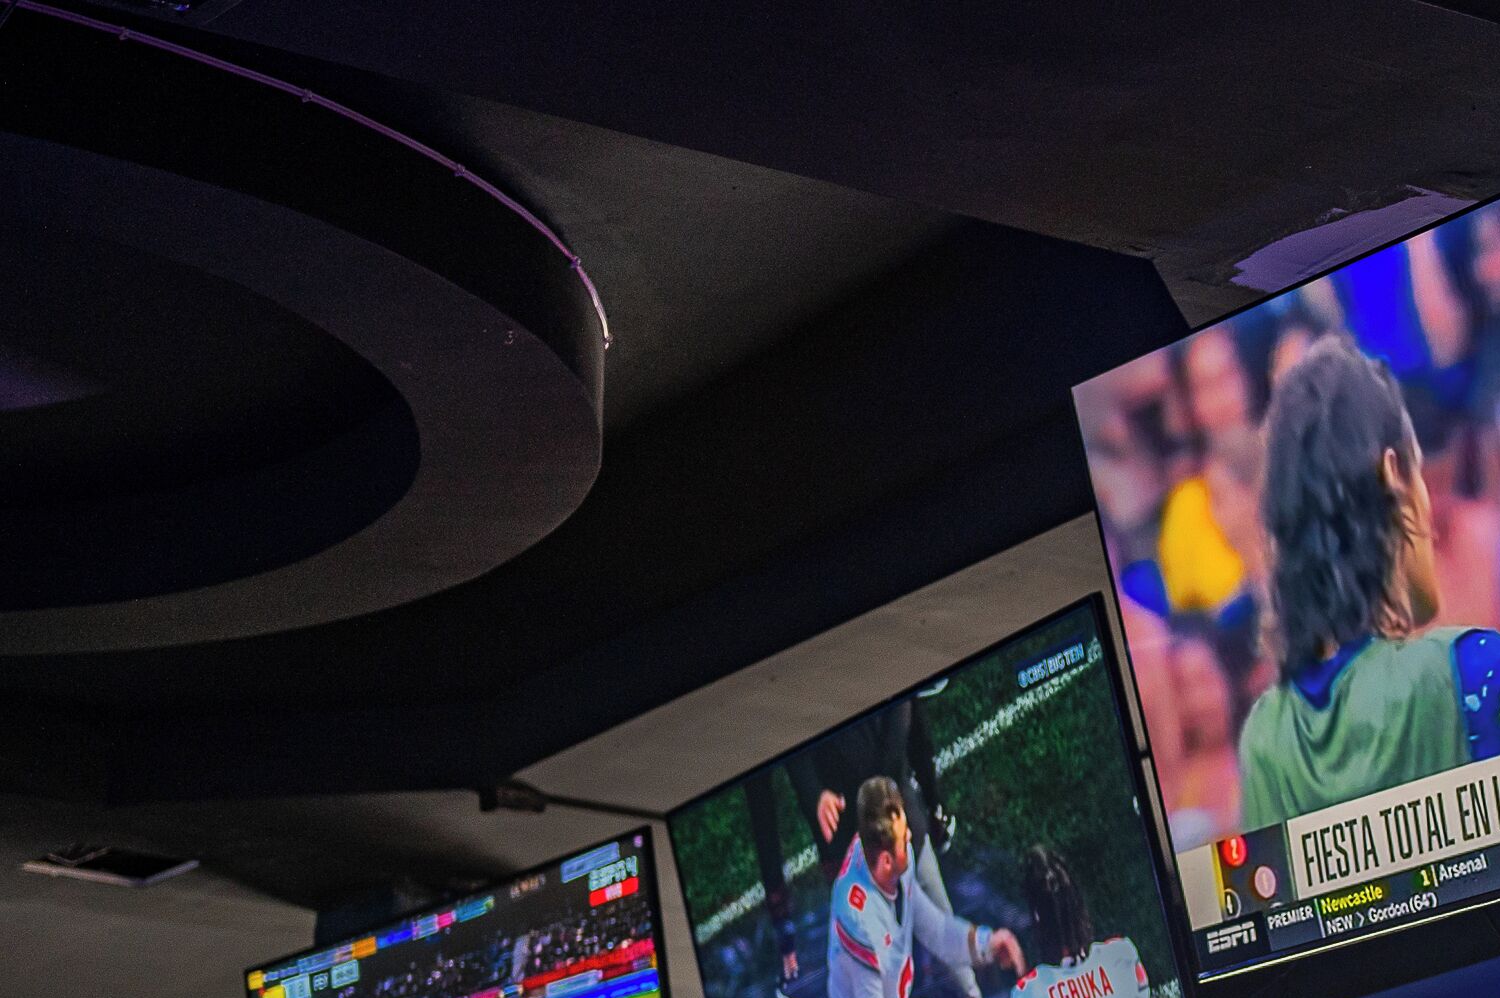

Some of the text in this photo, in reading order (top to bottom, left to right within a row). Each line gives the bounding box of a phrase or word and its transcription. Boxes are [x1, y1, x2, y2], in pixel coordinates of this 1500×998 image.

[1300, 813, 1380, 888] FIESTA
[1378, 791, 1456, 864] TOTAL
[1456, 779, 1493, 842] EN
[1320, 883, 1384, 916] Newcastle
[1419, 868, 1430, 888] 1
[1438, 852, 1488, 883] Arsenal
[1266, 904, 1314, 931] PREMIER
[1325, 914, 1354, 937] NEW
[1367, 901, 1411, 924] Gordon
[1206, 920, 1258, 955] ESPN
